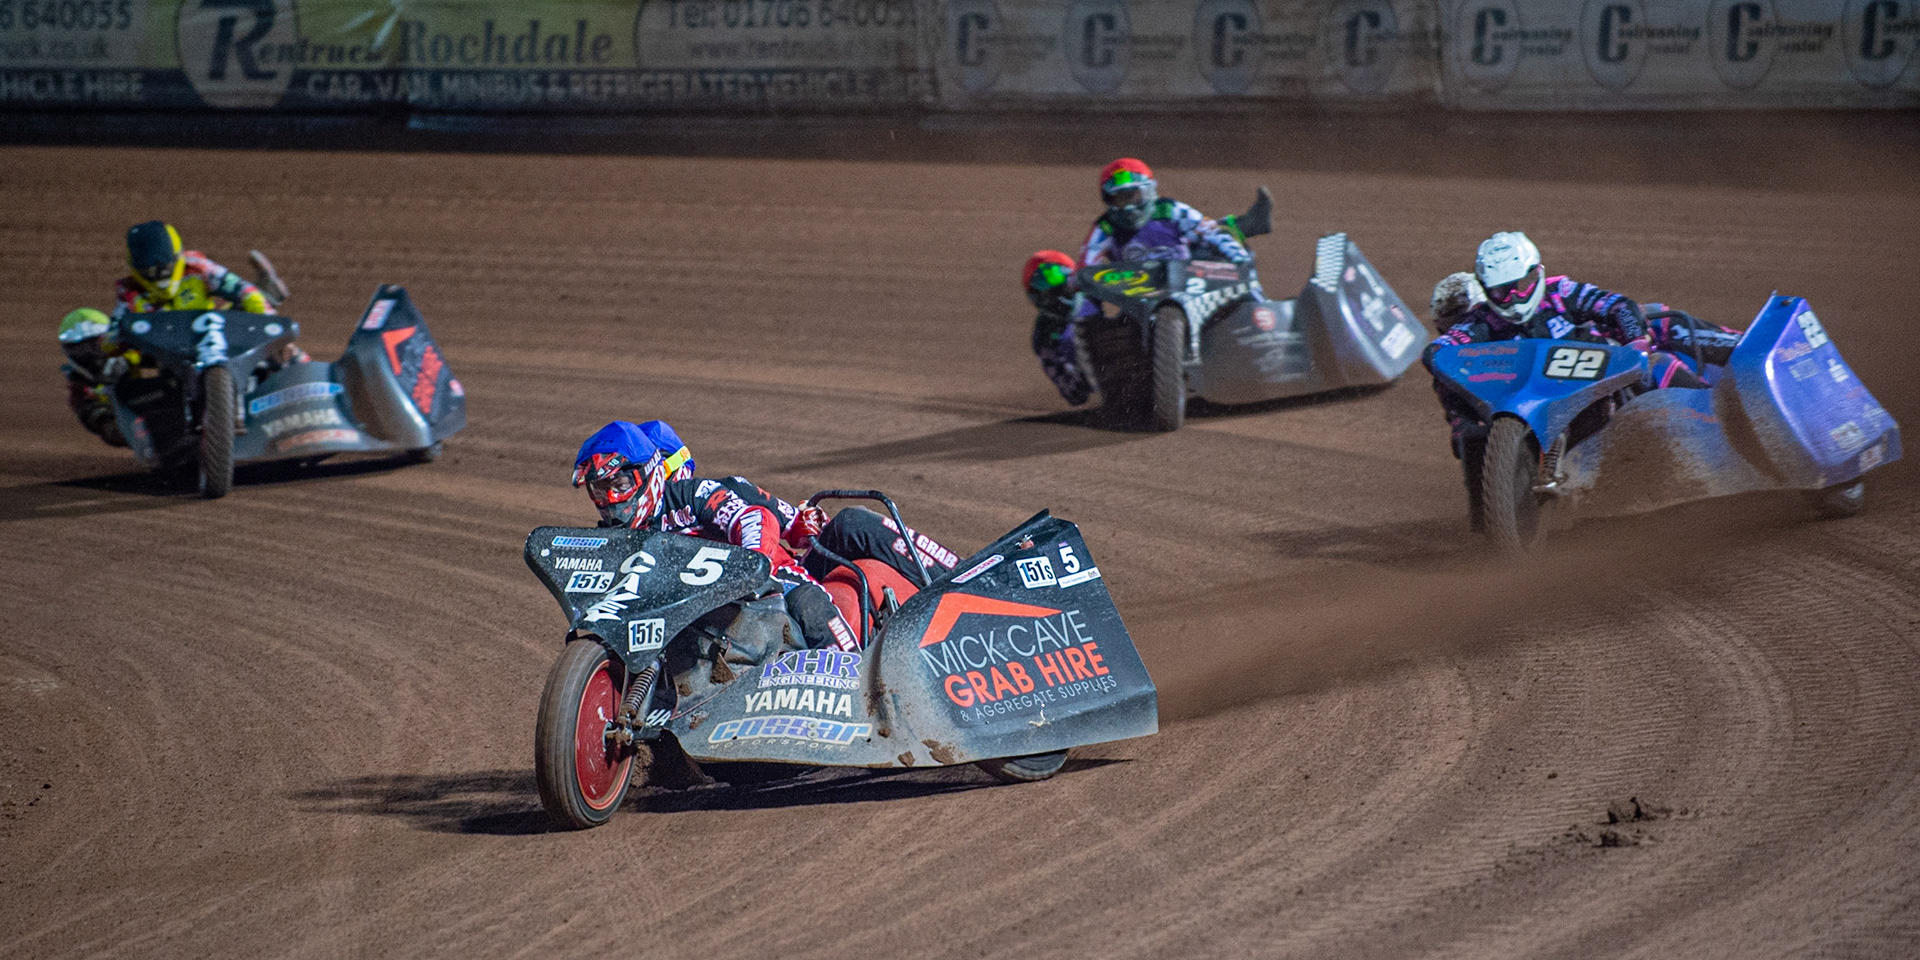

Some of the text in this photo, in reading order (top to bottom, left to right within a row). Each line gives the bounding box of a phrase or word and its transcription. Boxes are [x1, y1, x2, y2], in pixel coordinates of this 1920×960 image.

[401, 19, 613, 64] Rochdale
[1546, 348, 1606, 379] 22
[883, 516, 960, 570] ML GRAB
[554, 557, 603, 571] YAMAHA
[680, 547, 731, 586] 5
[1019, 560, 1054, 583] 151's
[1059, 546, 1081, 574] 5
[571, 573, 611, 590] 151's
[630, 621, 663, 646] 151's
[827, 616, 856, 652] MRL
[919, 609, 1093, 678] MICK CAVE
[760, 649, 862, 679] KHR
[944, 641, 1110, 708] GRAB HIRE
[757, 675, 861, 690] ENGINEERING
[745, 688, 852, 717] YAMAHA
[960, 675, 1117, 722] & AGGREGATE SUPPLIES
[709, 738, 848, 751] MOTORSPORT
